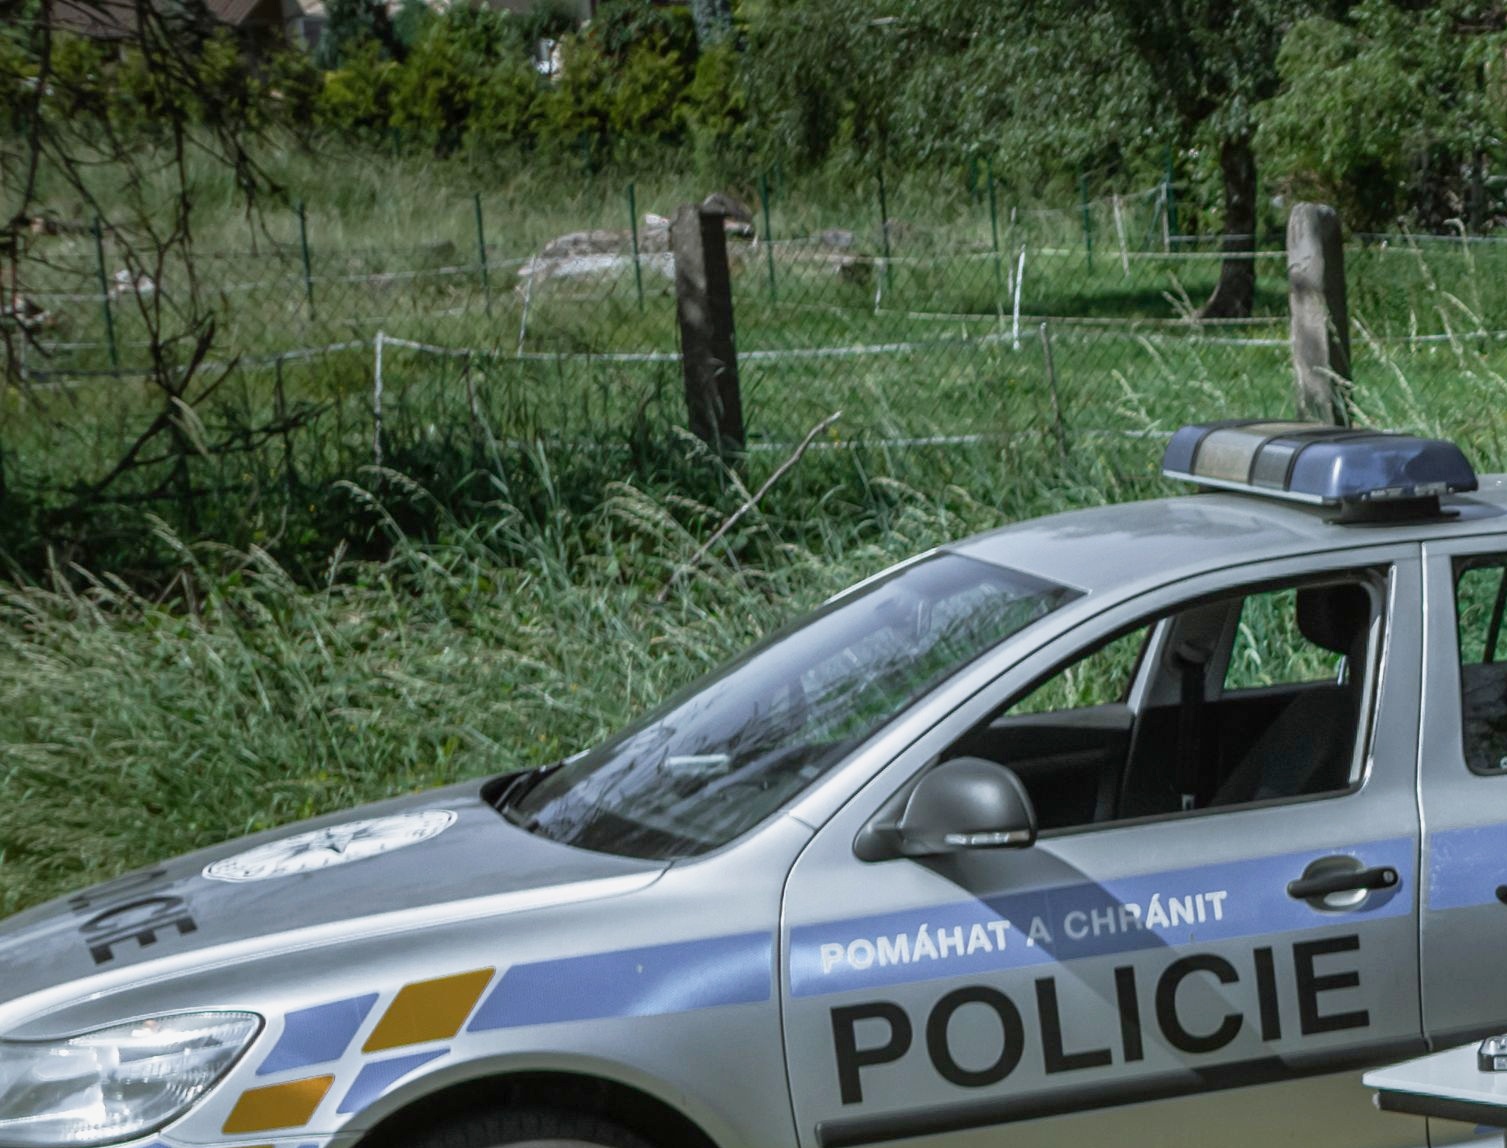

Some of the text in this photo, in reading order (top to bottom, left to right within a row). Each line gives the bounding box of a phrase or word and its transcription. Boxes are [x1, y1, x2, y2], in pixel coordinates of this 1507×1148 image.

[819, 890, 1228, 975] POMÁHAT A CHRÁNIT
[829, 933, 1371, 1106] POLICIE
